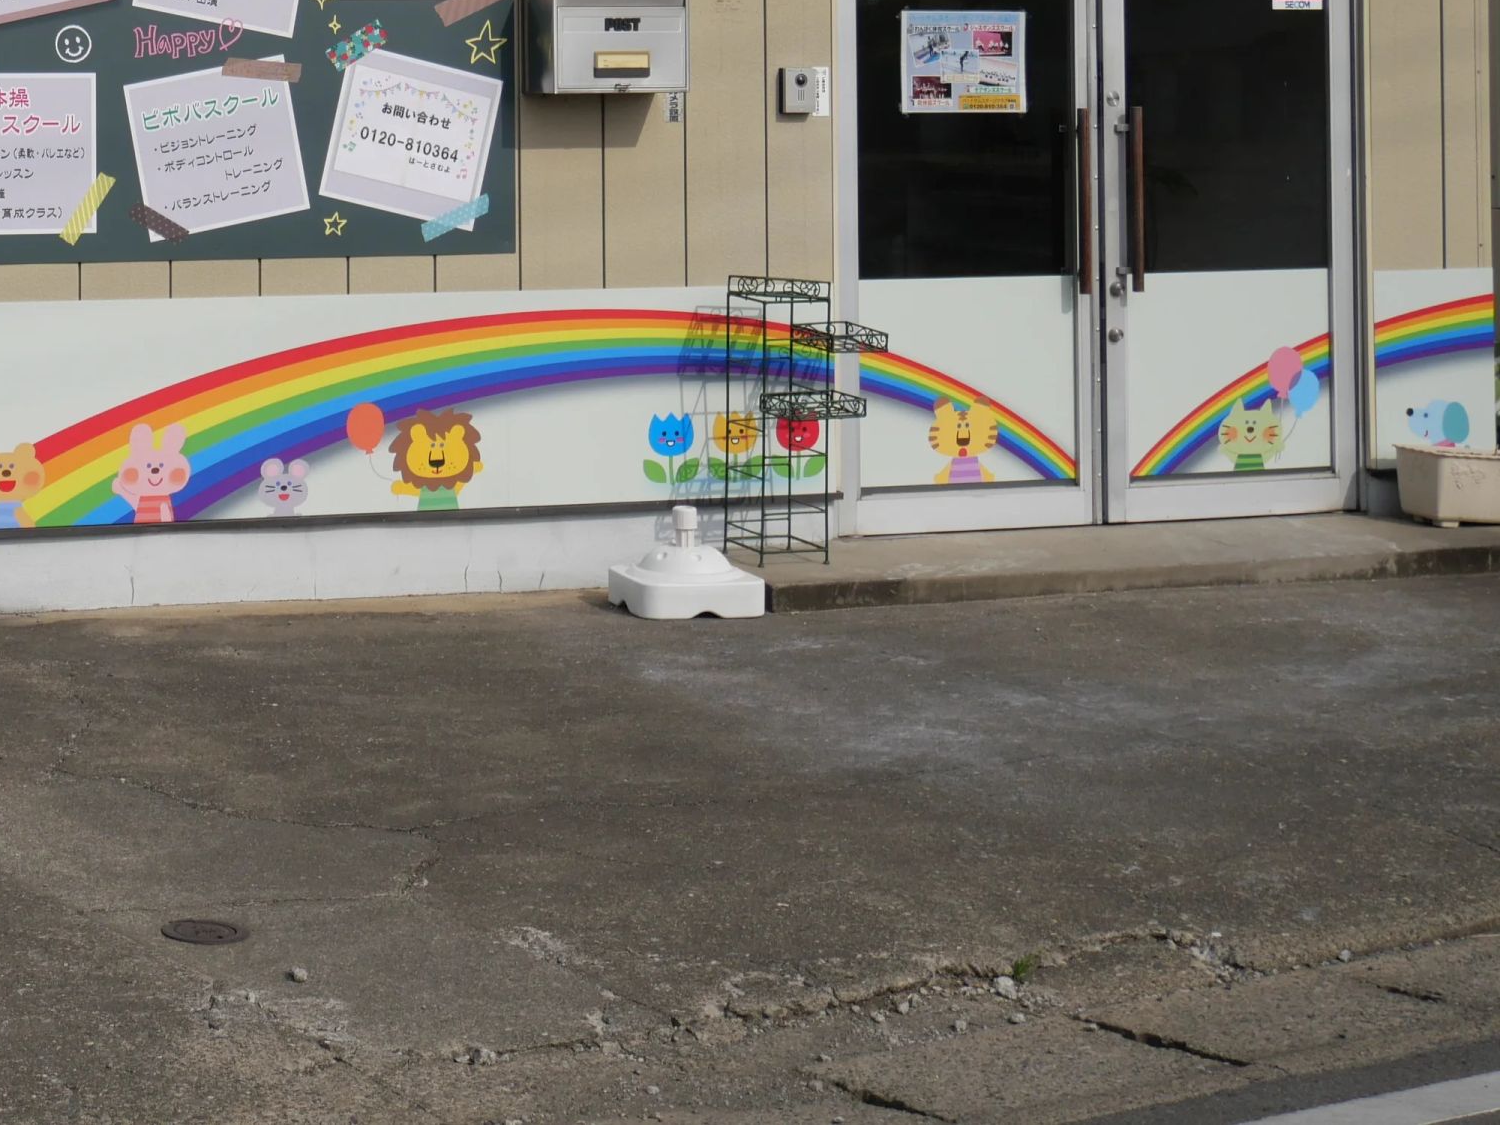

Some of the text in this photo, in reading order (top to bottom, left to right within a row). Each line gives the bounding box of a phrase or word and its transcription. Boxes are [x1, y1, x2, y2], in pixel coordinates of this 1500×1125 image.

[1284, 0, 1311, 9] SECOM
[604, 17, 641, 32] POST
[133, 24, 216, 59] Happy
[1, 114, 82, 135] スクール
[381, 102, 452, 130] お問い合わせ
[360, 126, 459, 163] 0120-810364
[224, 157, 284, 181] トレーニング
